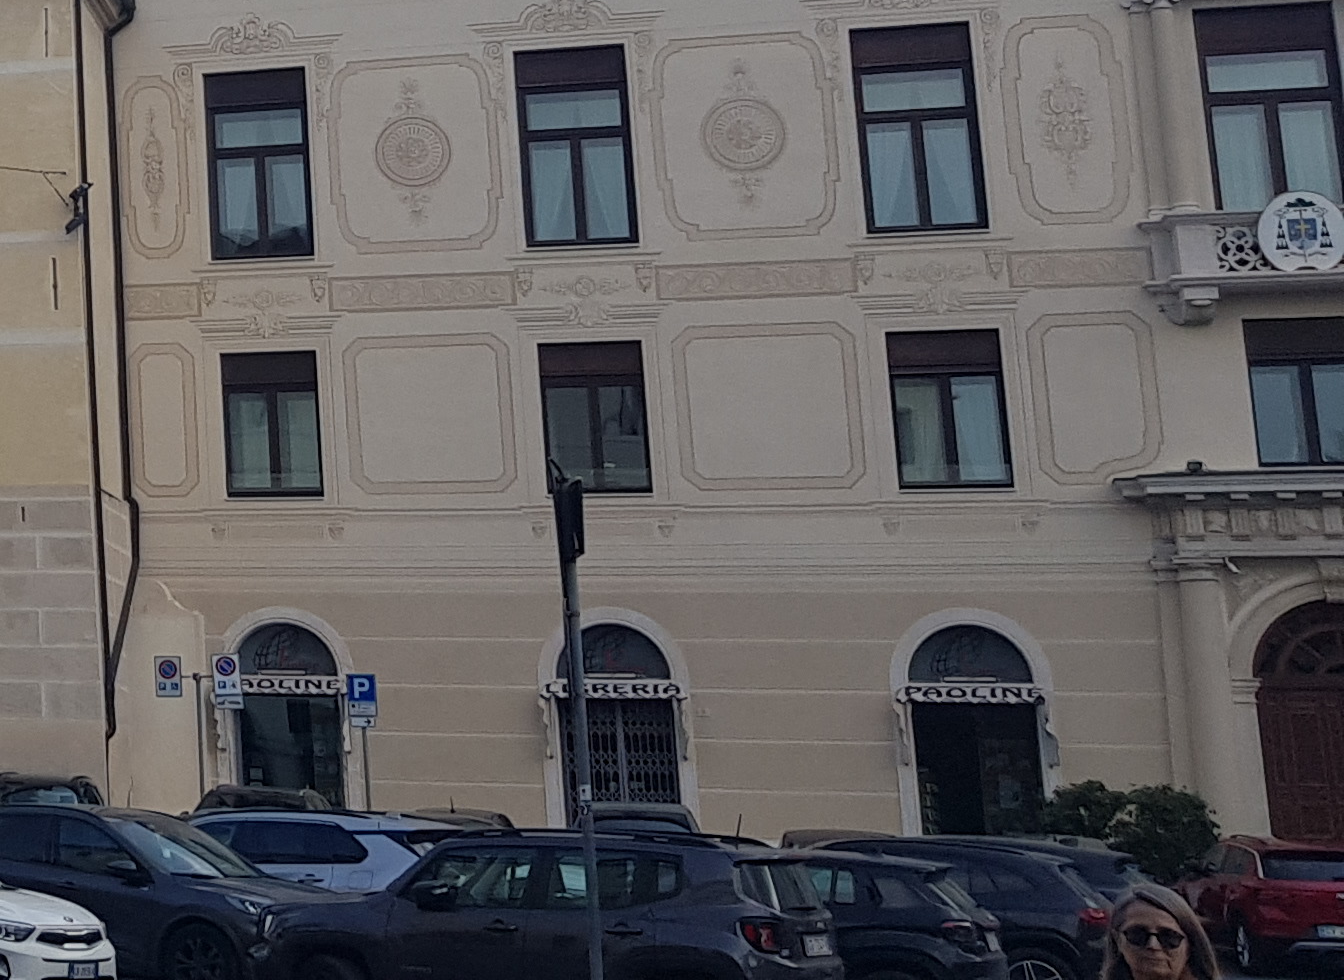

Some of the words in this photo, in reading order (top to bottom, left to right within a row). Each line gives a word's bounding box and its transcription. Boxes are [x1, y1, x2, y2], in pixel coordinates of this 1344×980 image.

[241, 678, 340, 691] AOLINE
[353, 677, 370, 699] P
[545, 682, 682, 695] LIRERIA
